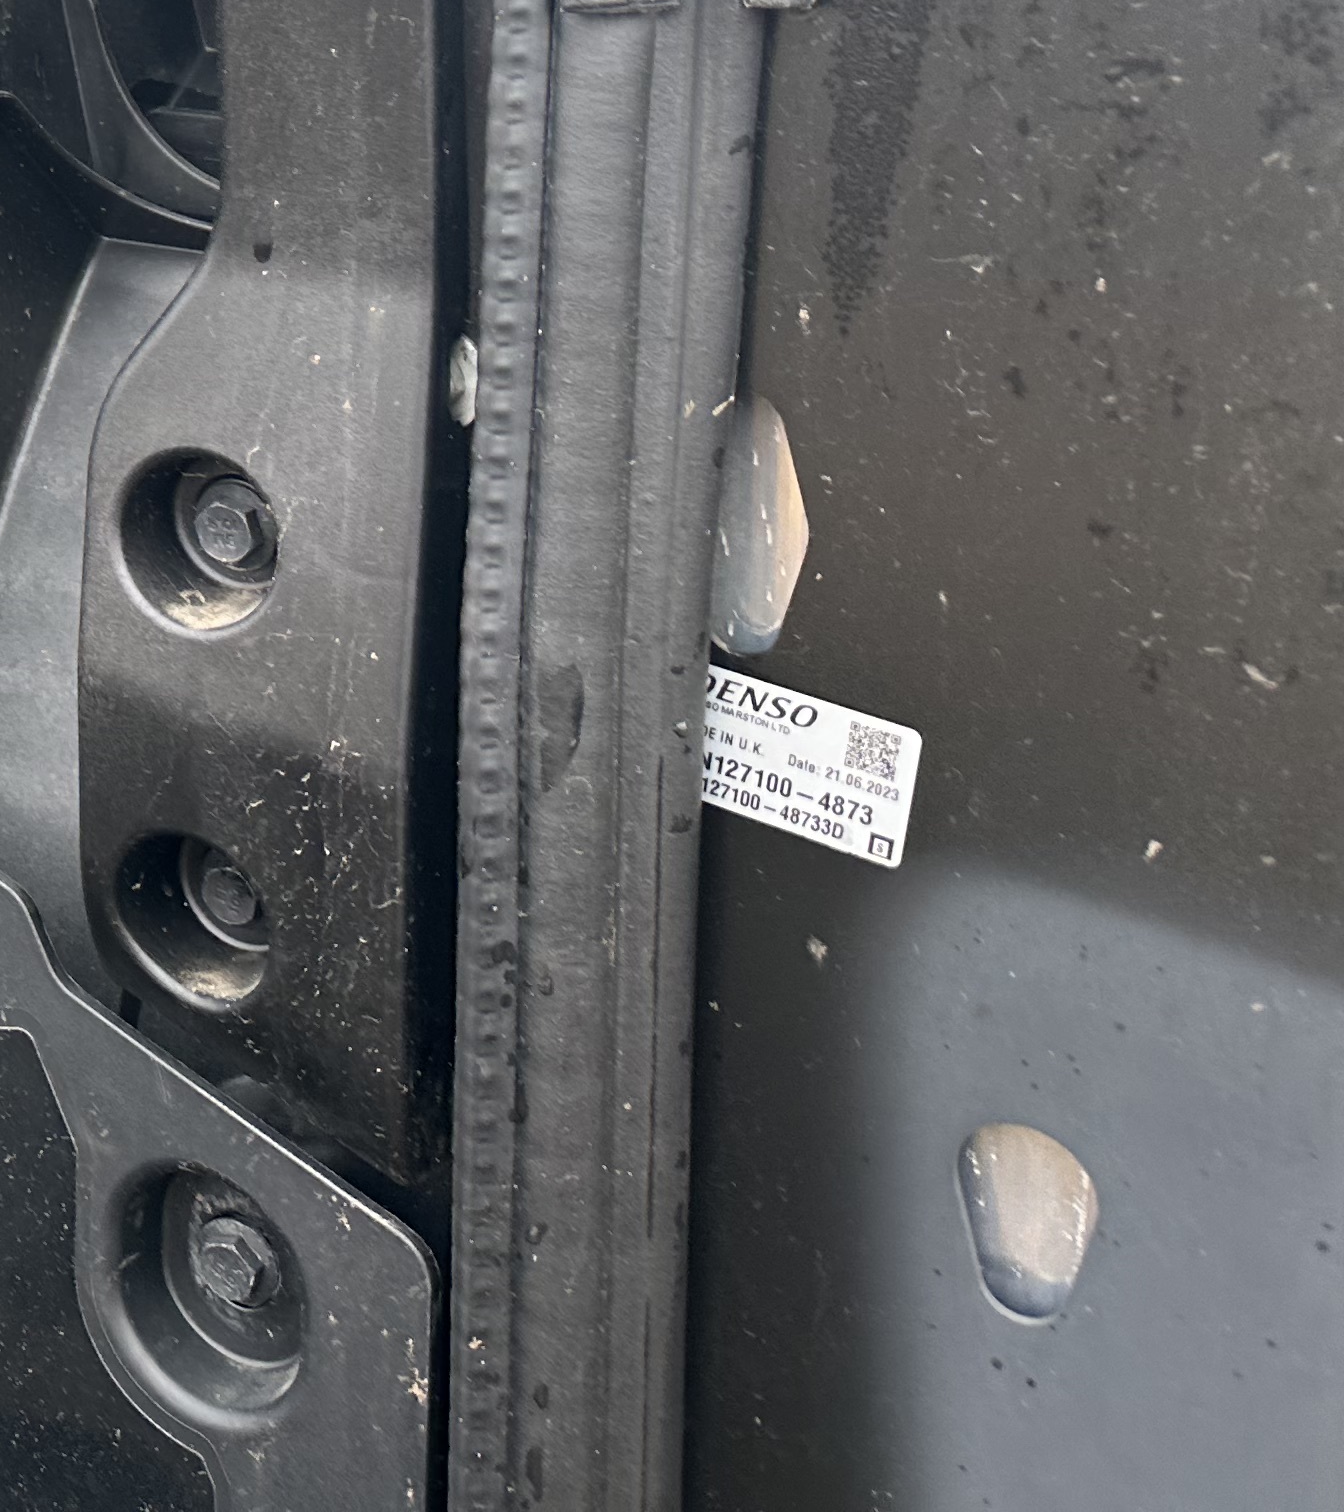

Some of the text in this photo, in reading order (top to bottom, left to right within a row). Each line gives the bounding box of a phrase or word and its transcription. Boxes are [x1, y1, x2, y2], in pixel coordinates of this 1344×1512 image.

[721, 706, 770, 730] MARSTON
[772, 721, 791, 736] LTD
[720, 730, 734, 747] IN
[787, 753, 901, 803] Date: 21.06.2023
